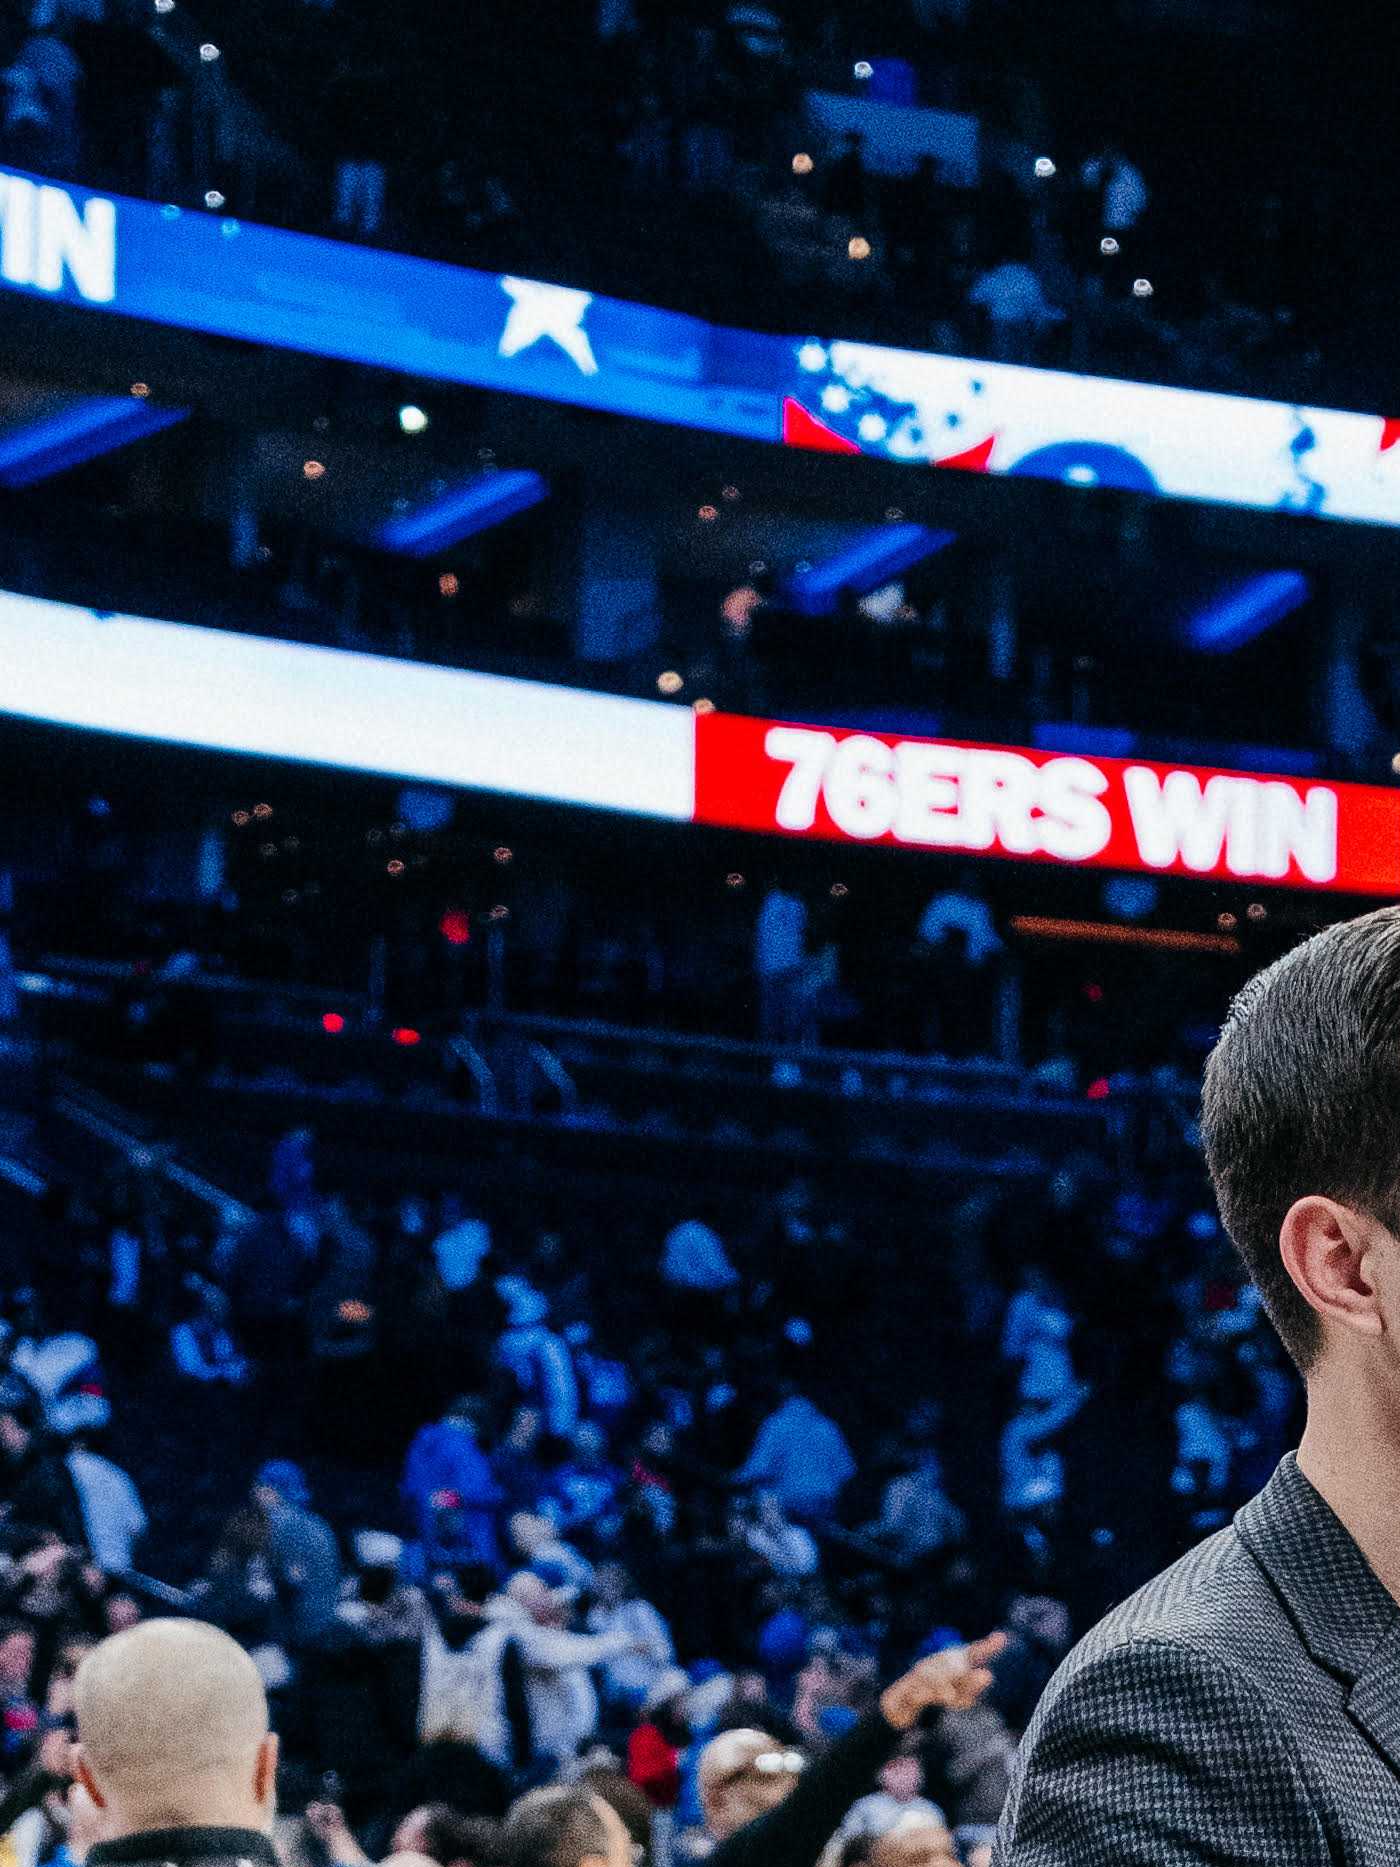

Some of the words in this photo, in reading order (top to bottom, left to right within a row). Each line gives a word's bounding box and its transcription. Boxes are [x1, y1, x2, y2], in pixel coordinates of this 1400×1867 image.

[0, 173, 116, 303] IN
[765, 727, 1111, 861] 76ERS
[1123, 765, 1338, 882] WIN
